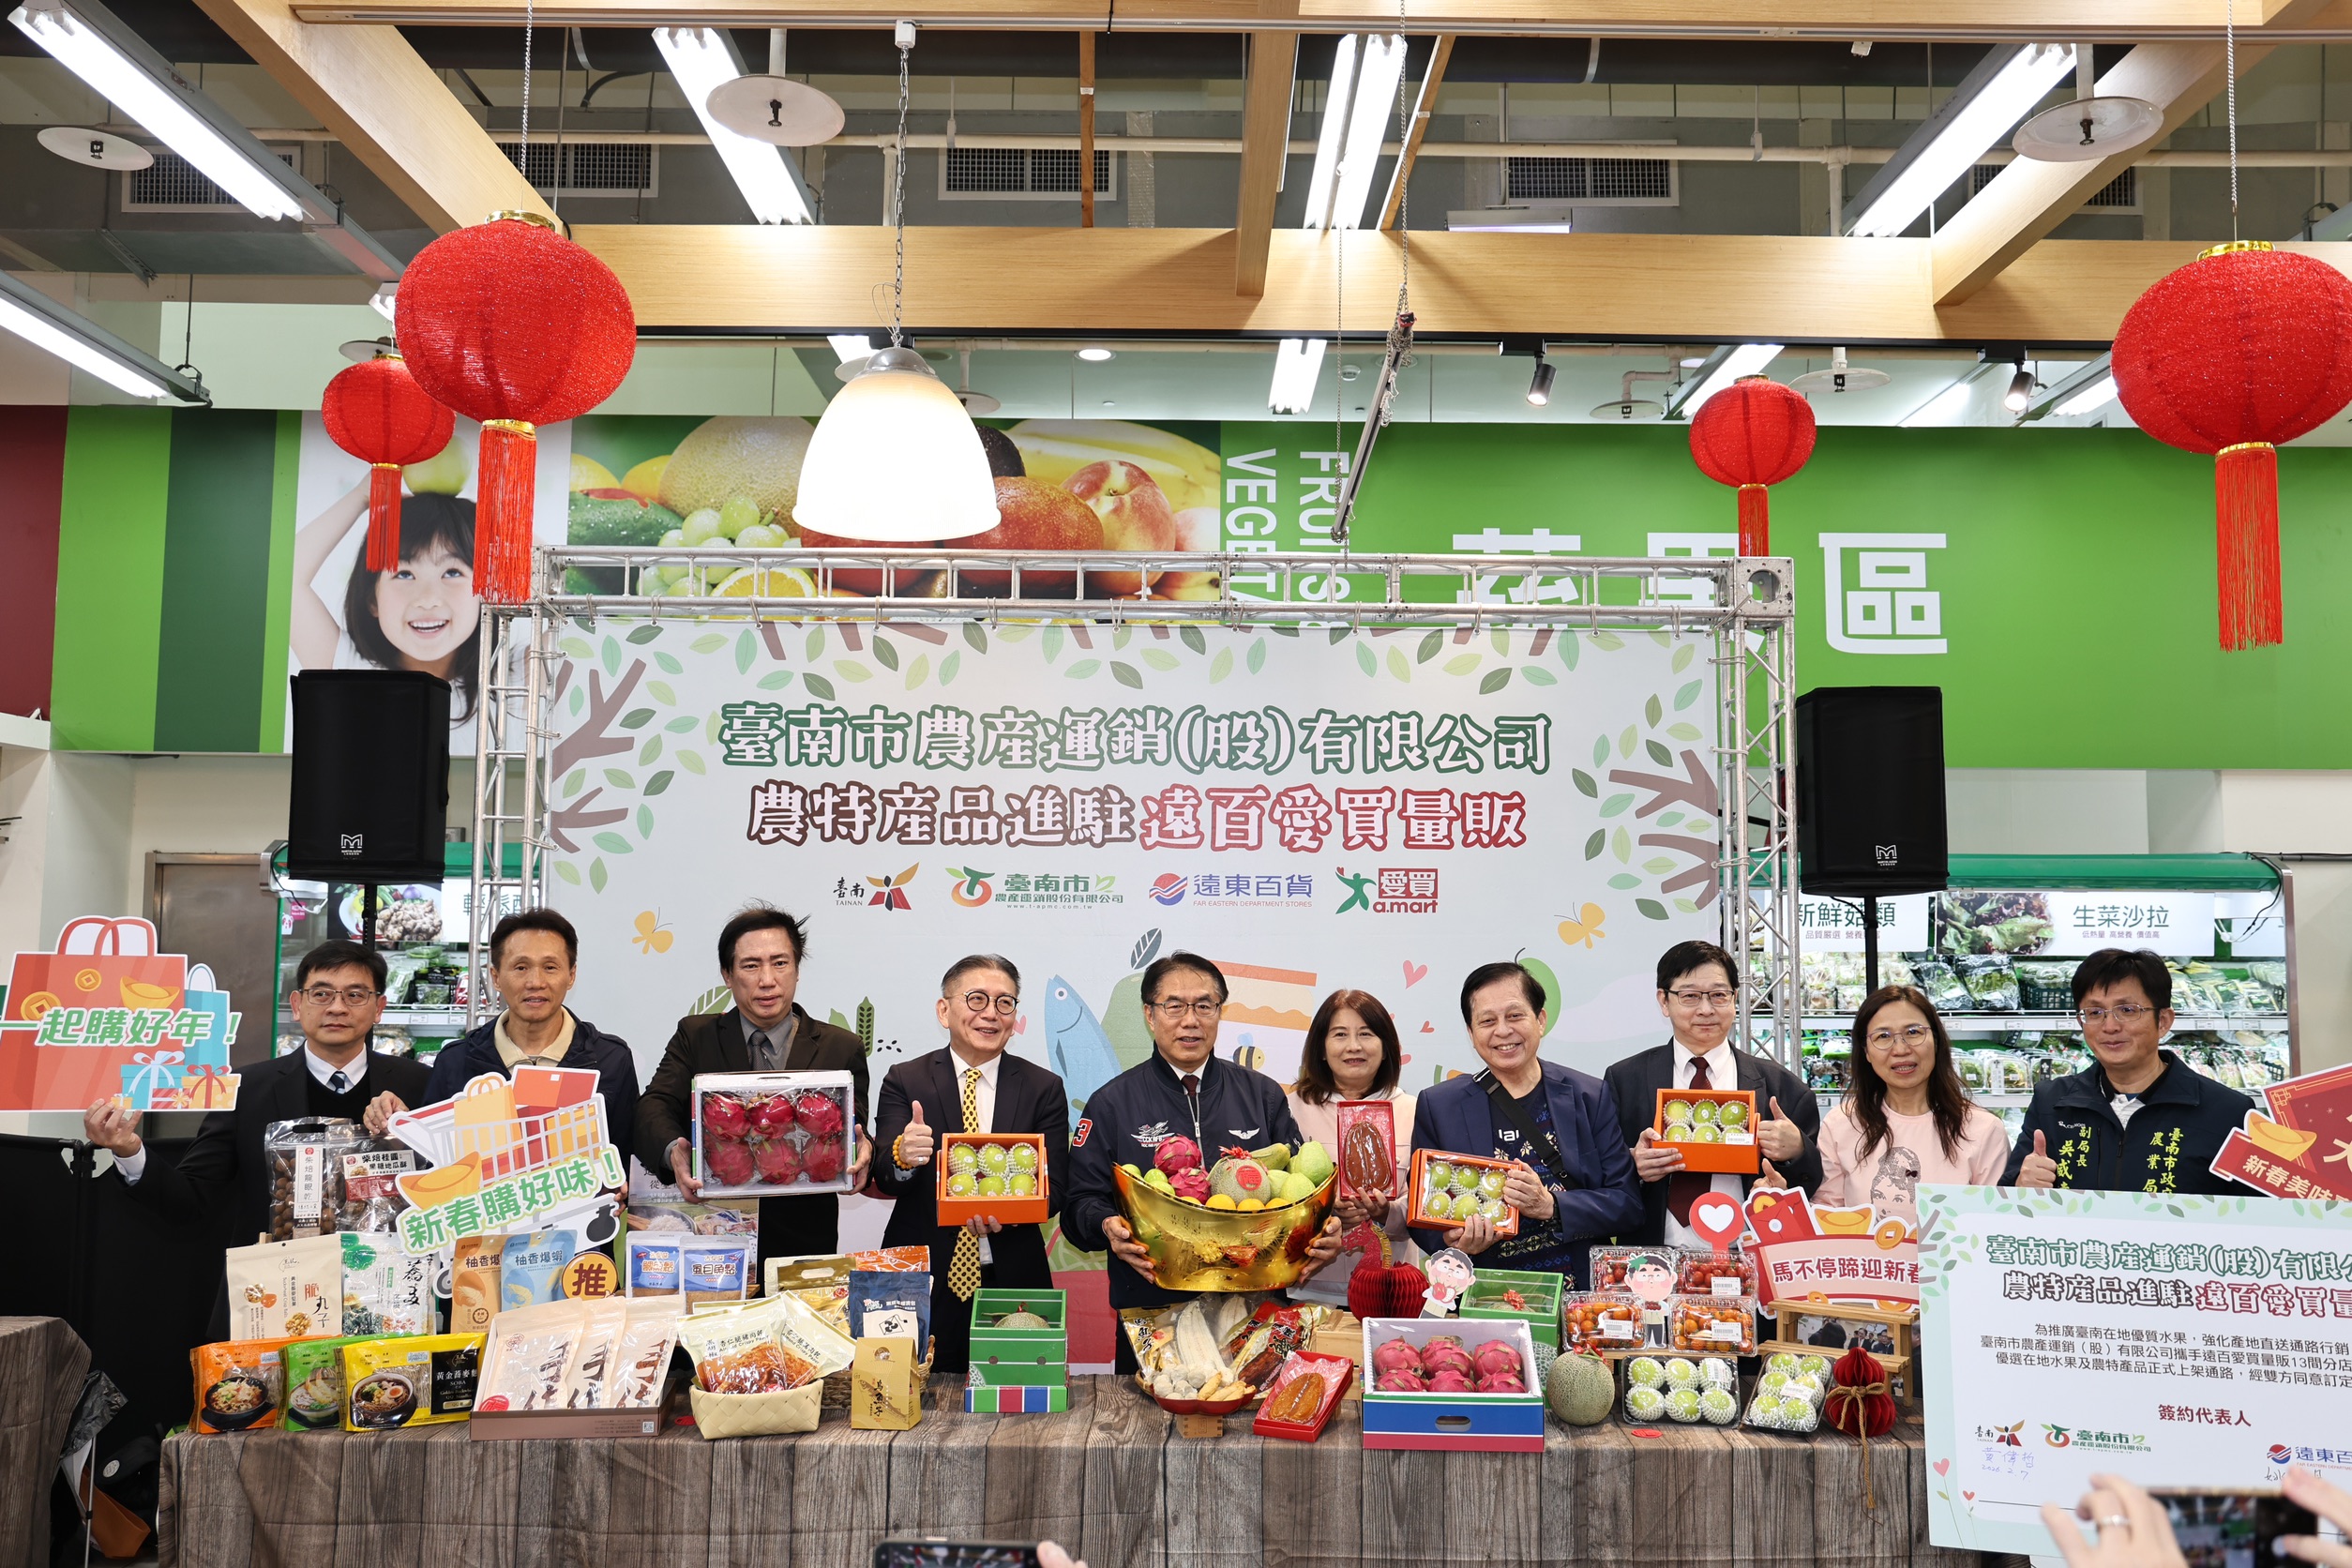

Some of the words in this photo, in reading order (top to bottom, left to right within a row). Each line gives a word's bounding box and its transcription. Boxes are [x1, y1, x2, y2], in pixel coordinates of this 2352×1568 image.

[833, 876, 865, 898] 臺南
[1004, 873, 1091, 893] 臺南市
[1193, 873, 1314, 897] 遠東百貨
[1380, 869, 1437, 898] 愛買
[1372, 900, 1439, 913] a.mart
[2073, 905, 2169, 927] 生菜沙拉
[2082, 930, 2105, 939] 低熱量
[2109, 930, 2133, 939] 高營養
[2136, 930, 2160, 939] 價值高
[1073, 1118, 1093, 1147] 3
[2076, 1126, 2092, 1167] 副局長
[2143, 1131, 2164, 1193] 農業局
[515, 1250, 563, 1267] 柚香爆蝦
[572, 1263, 608, 1296] 推
[2158, 1404, 2252, 1427] 簽約代表人
[2076, 1429, 2130, 1444] 臺南市
